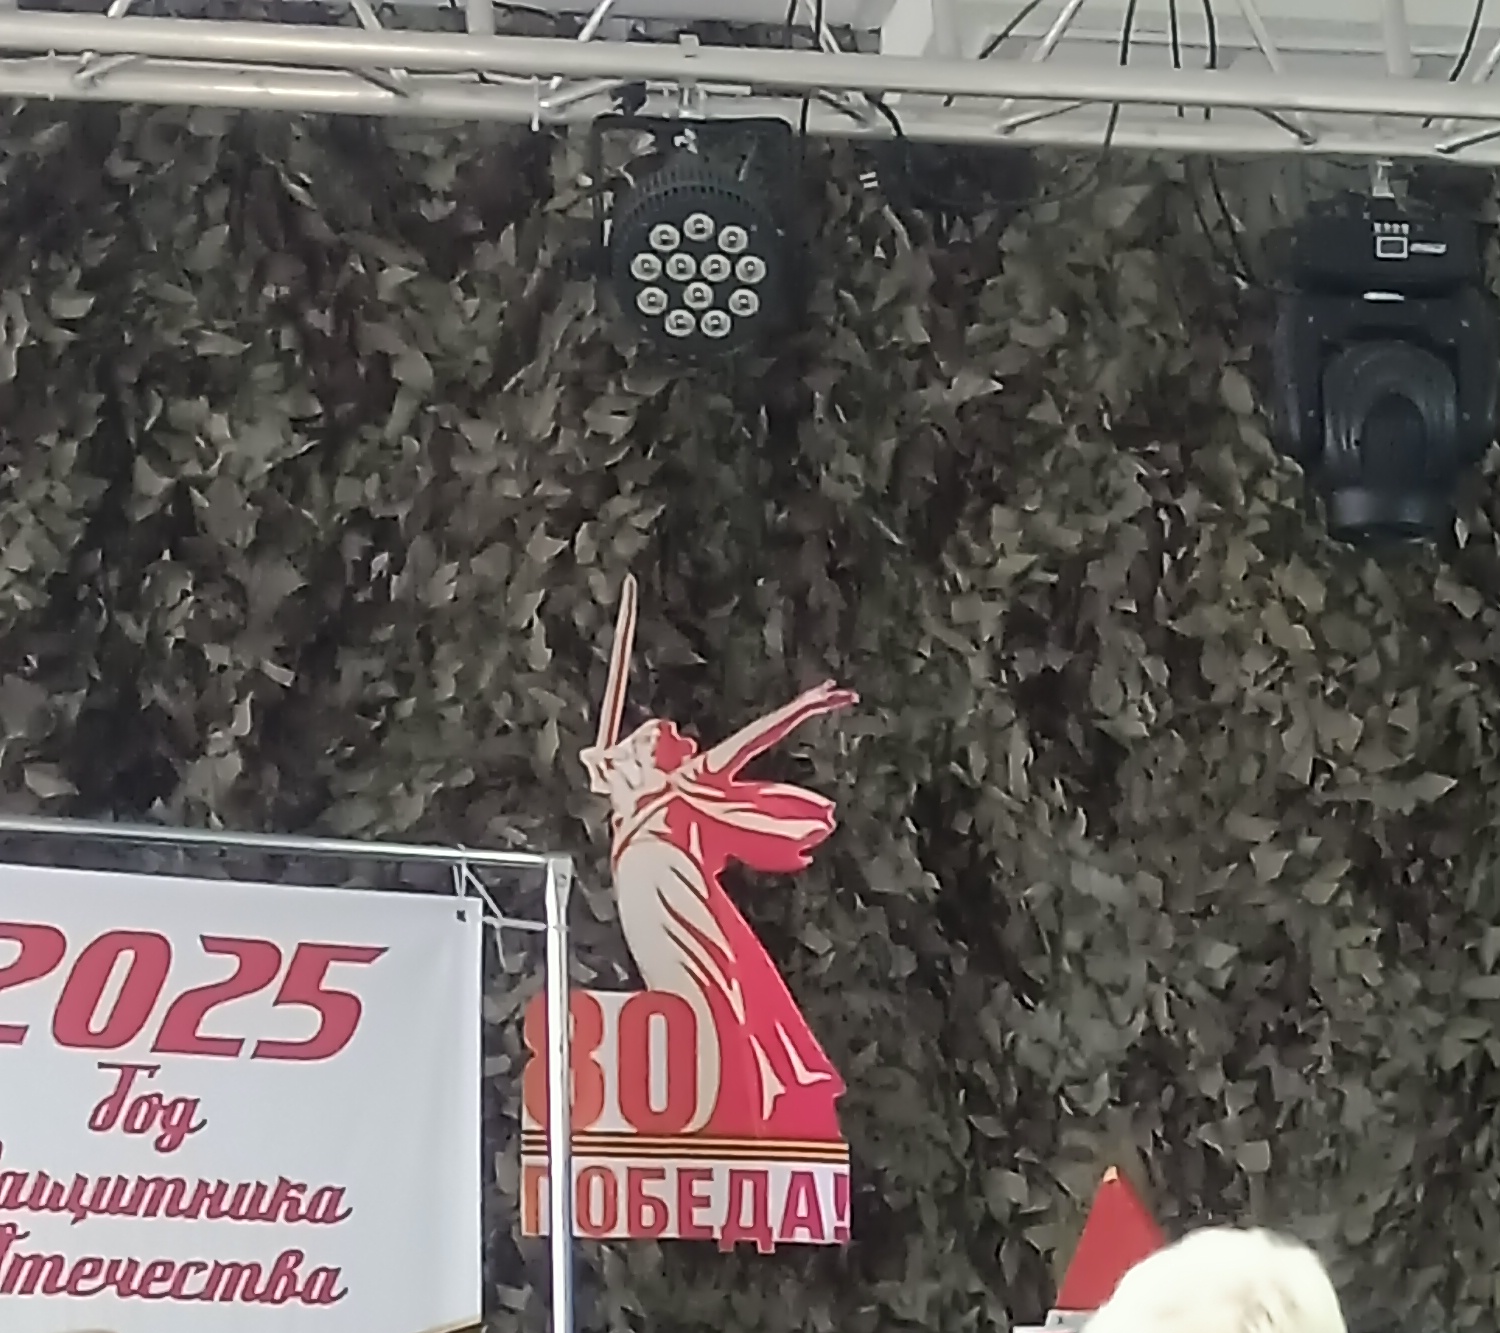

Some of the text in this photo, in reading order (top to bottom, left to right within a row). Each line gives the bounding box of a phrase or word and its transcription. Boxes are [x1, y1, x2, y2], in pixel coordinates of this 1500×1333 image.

[0, 921, 389, 1061] 2025
[88, 1061, 207, 1152] Год
[523, 990, 699, 1136] 80
[0, 1168, 353, 1225] ащитника
